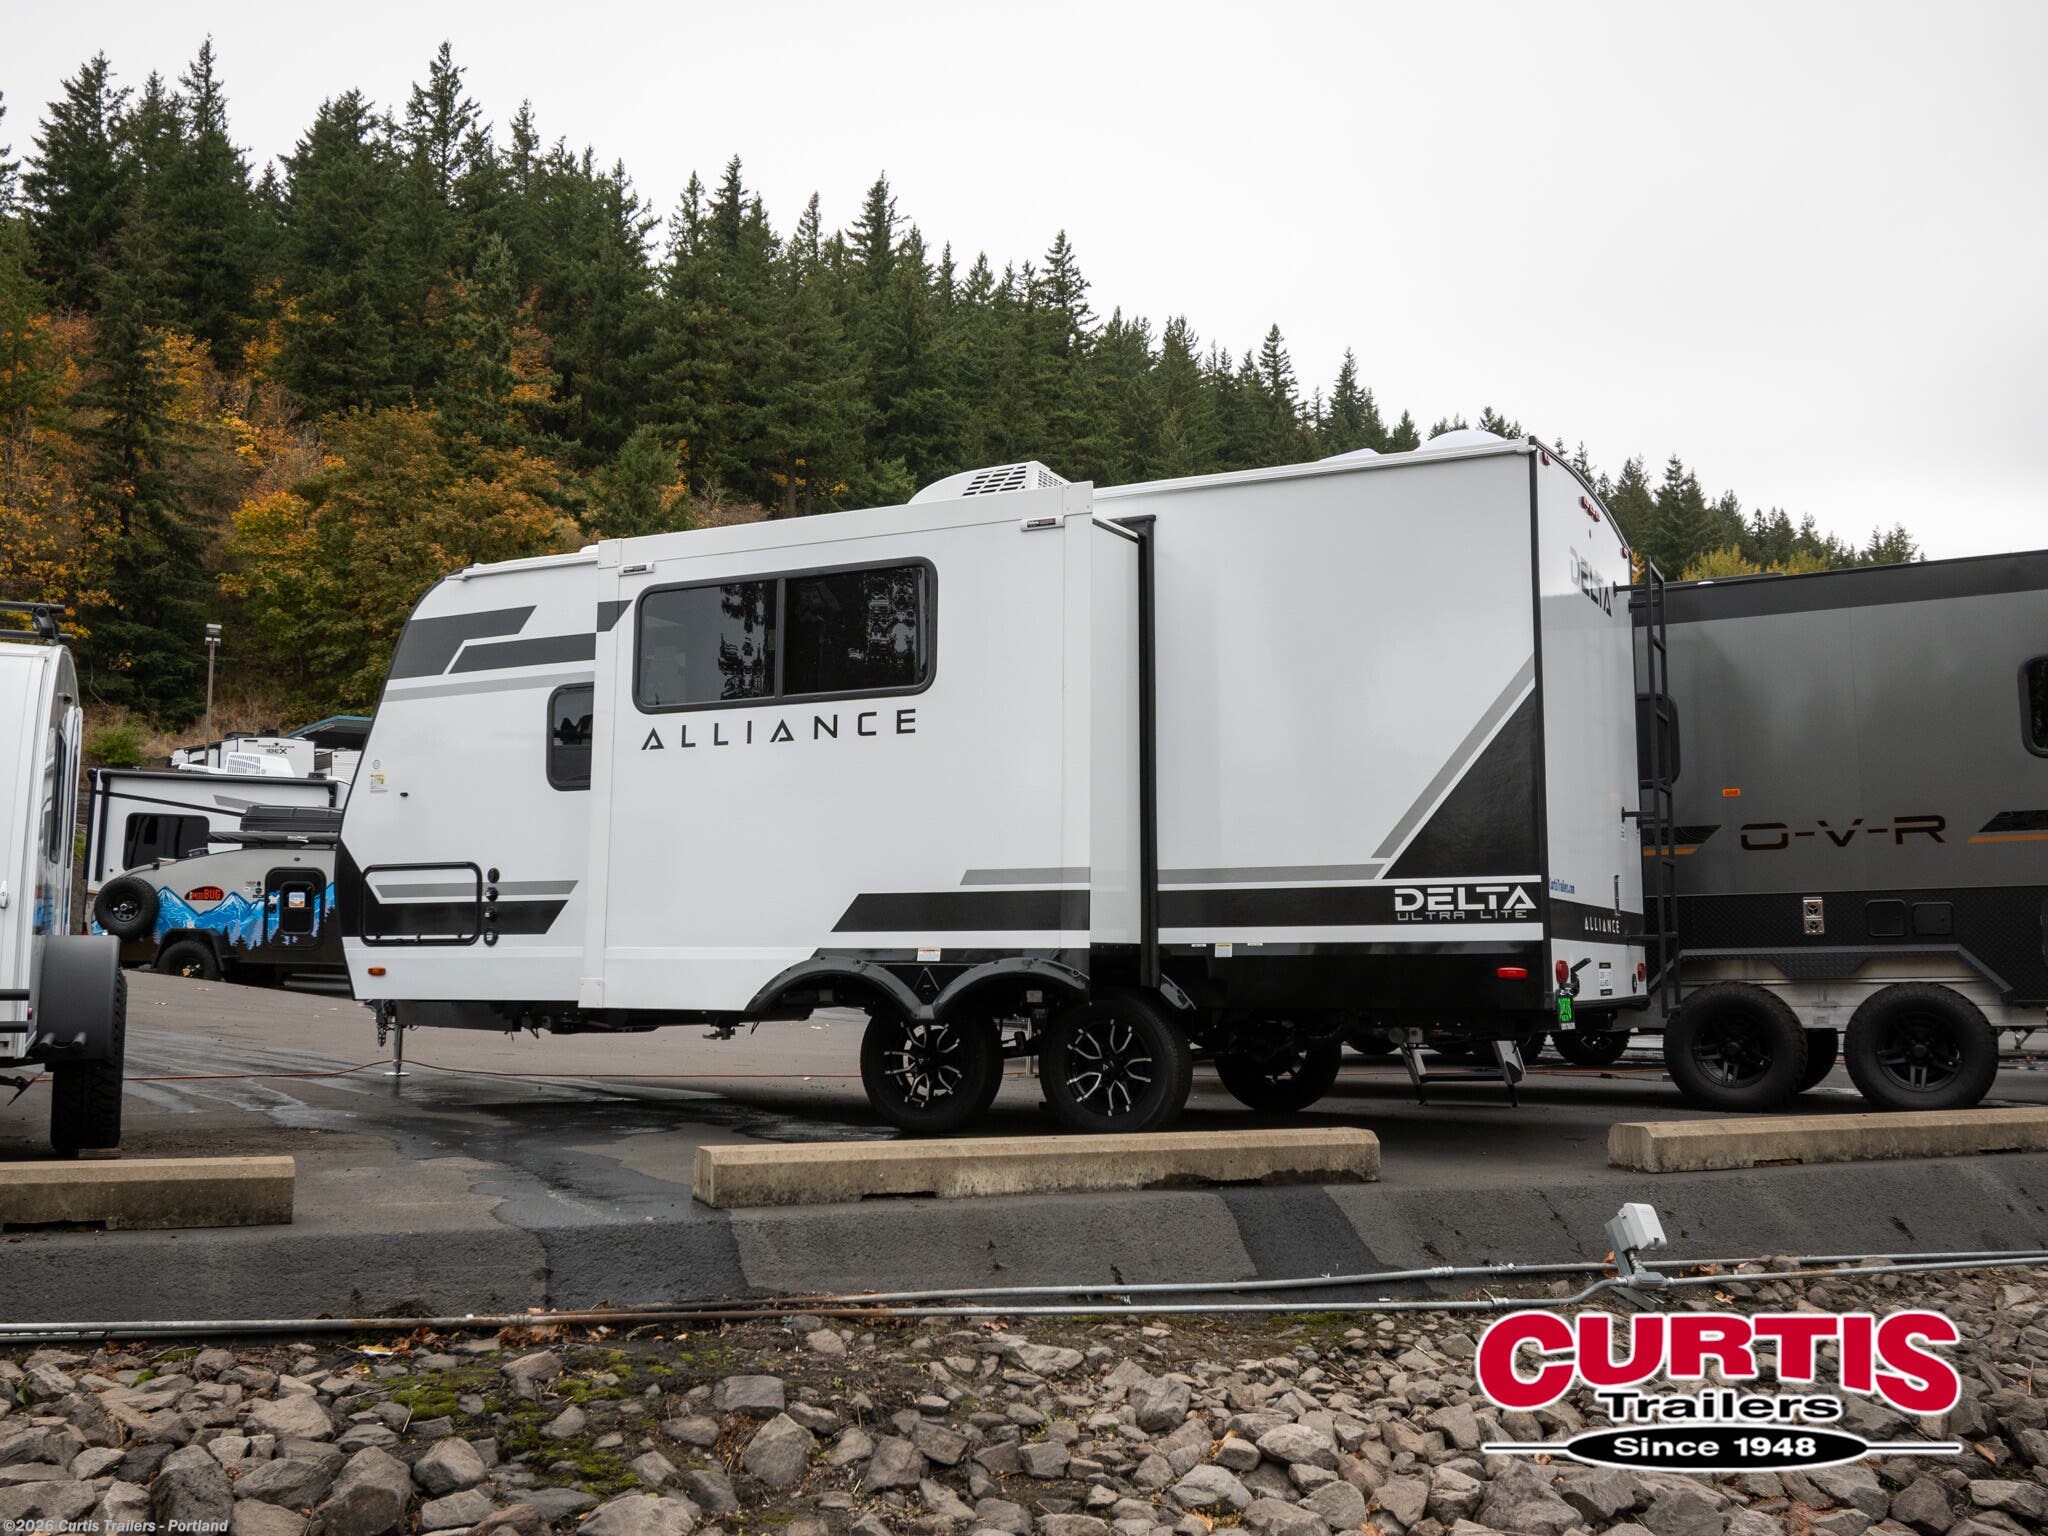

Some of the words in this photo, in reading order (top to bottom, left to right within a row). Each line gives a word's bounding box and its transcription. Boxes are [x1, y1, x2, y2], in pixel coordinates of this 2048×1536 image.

[1570, 545, 1612, 617] DELTA
[641, 708, 916, 751] ALLIANCE
[1740, 815, 1946, 850] O-V-R
[1394, 885, 1536, 911] DELTA
[1397, 911, 1465, 921] ULTRA
[1480, 910, 1527, 919] LITE
[1584, 916, 1620, 934] ALLIANCE
